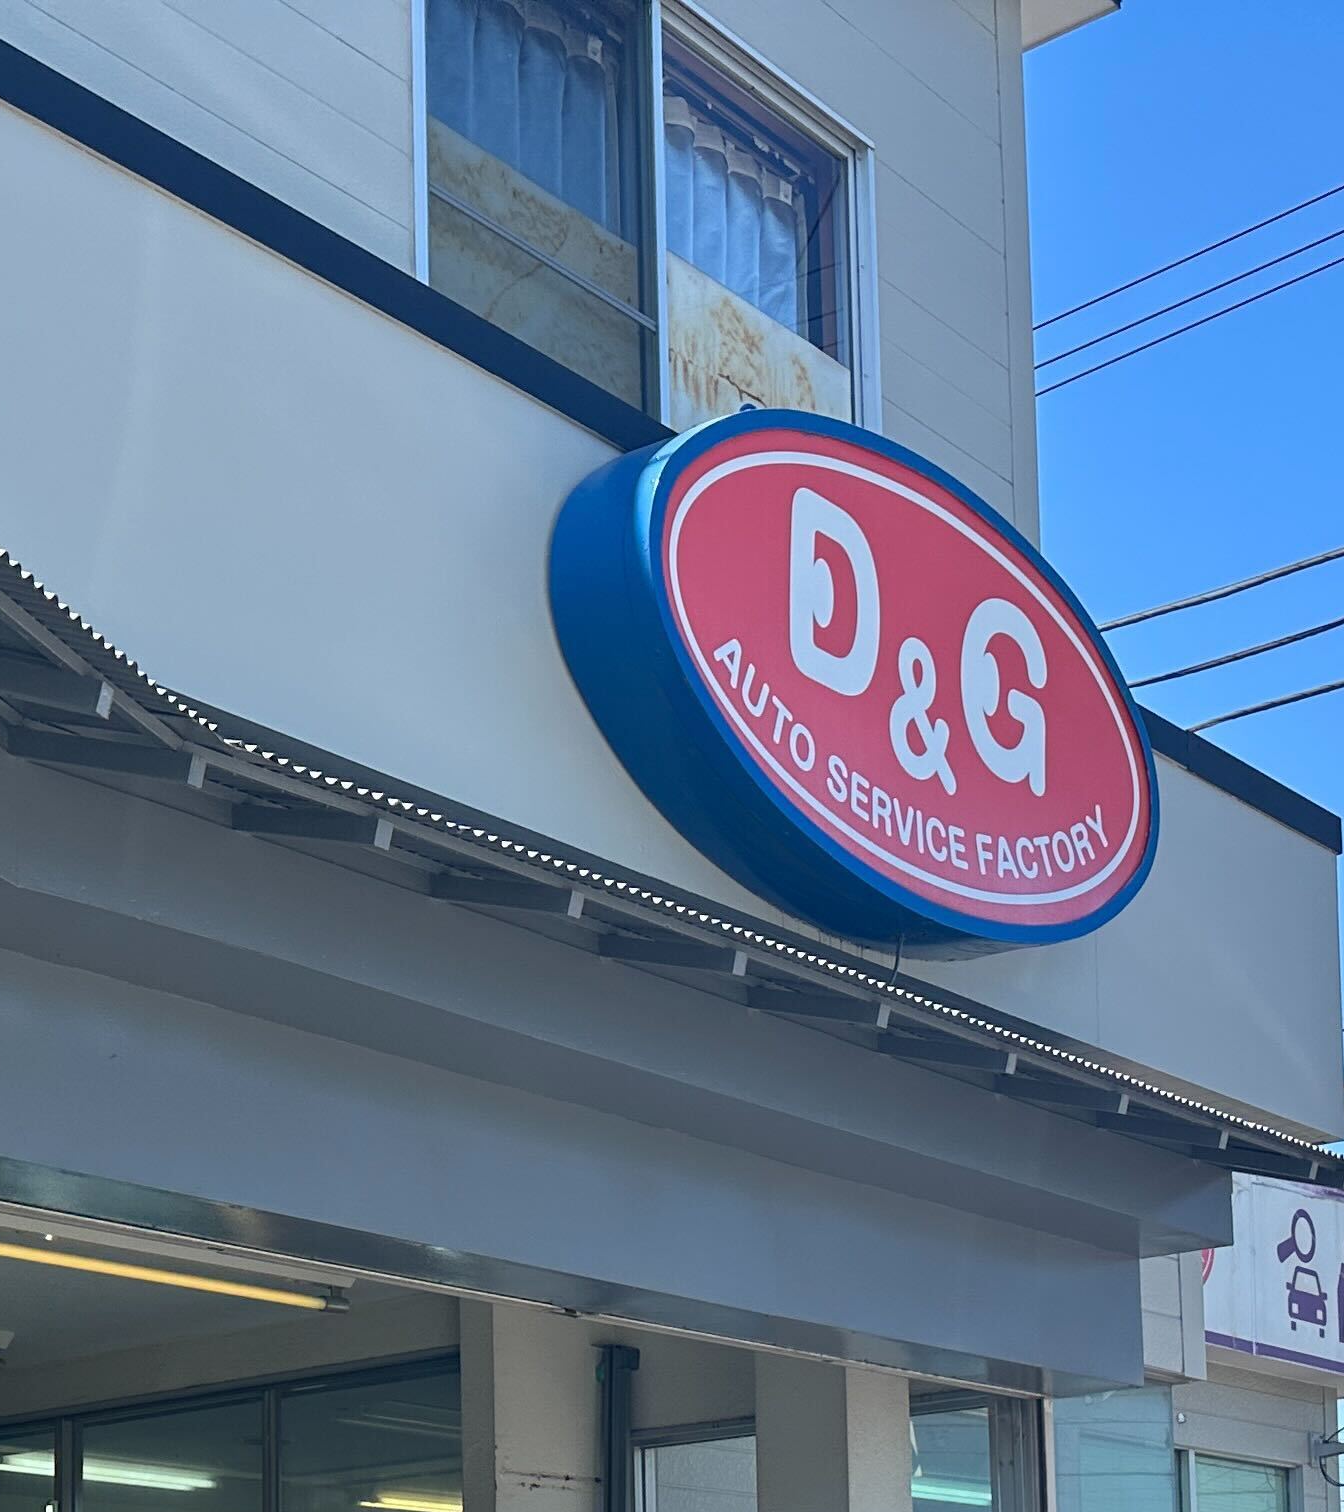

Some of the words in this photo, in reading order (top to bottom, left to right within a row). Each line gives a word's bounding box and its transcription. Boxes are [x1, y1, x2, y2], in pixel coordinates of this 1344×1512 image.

[713, 638, 816, 772] AUTO
[826, 755, 969, 871] SERVICE
[975, 804, 1109, 880] FACTORY
